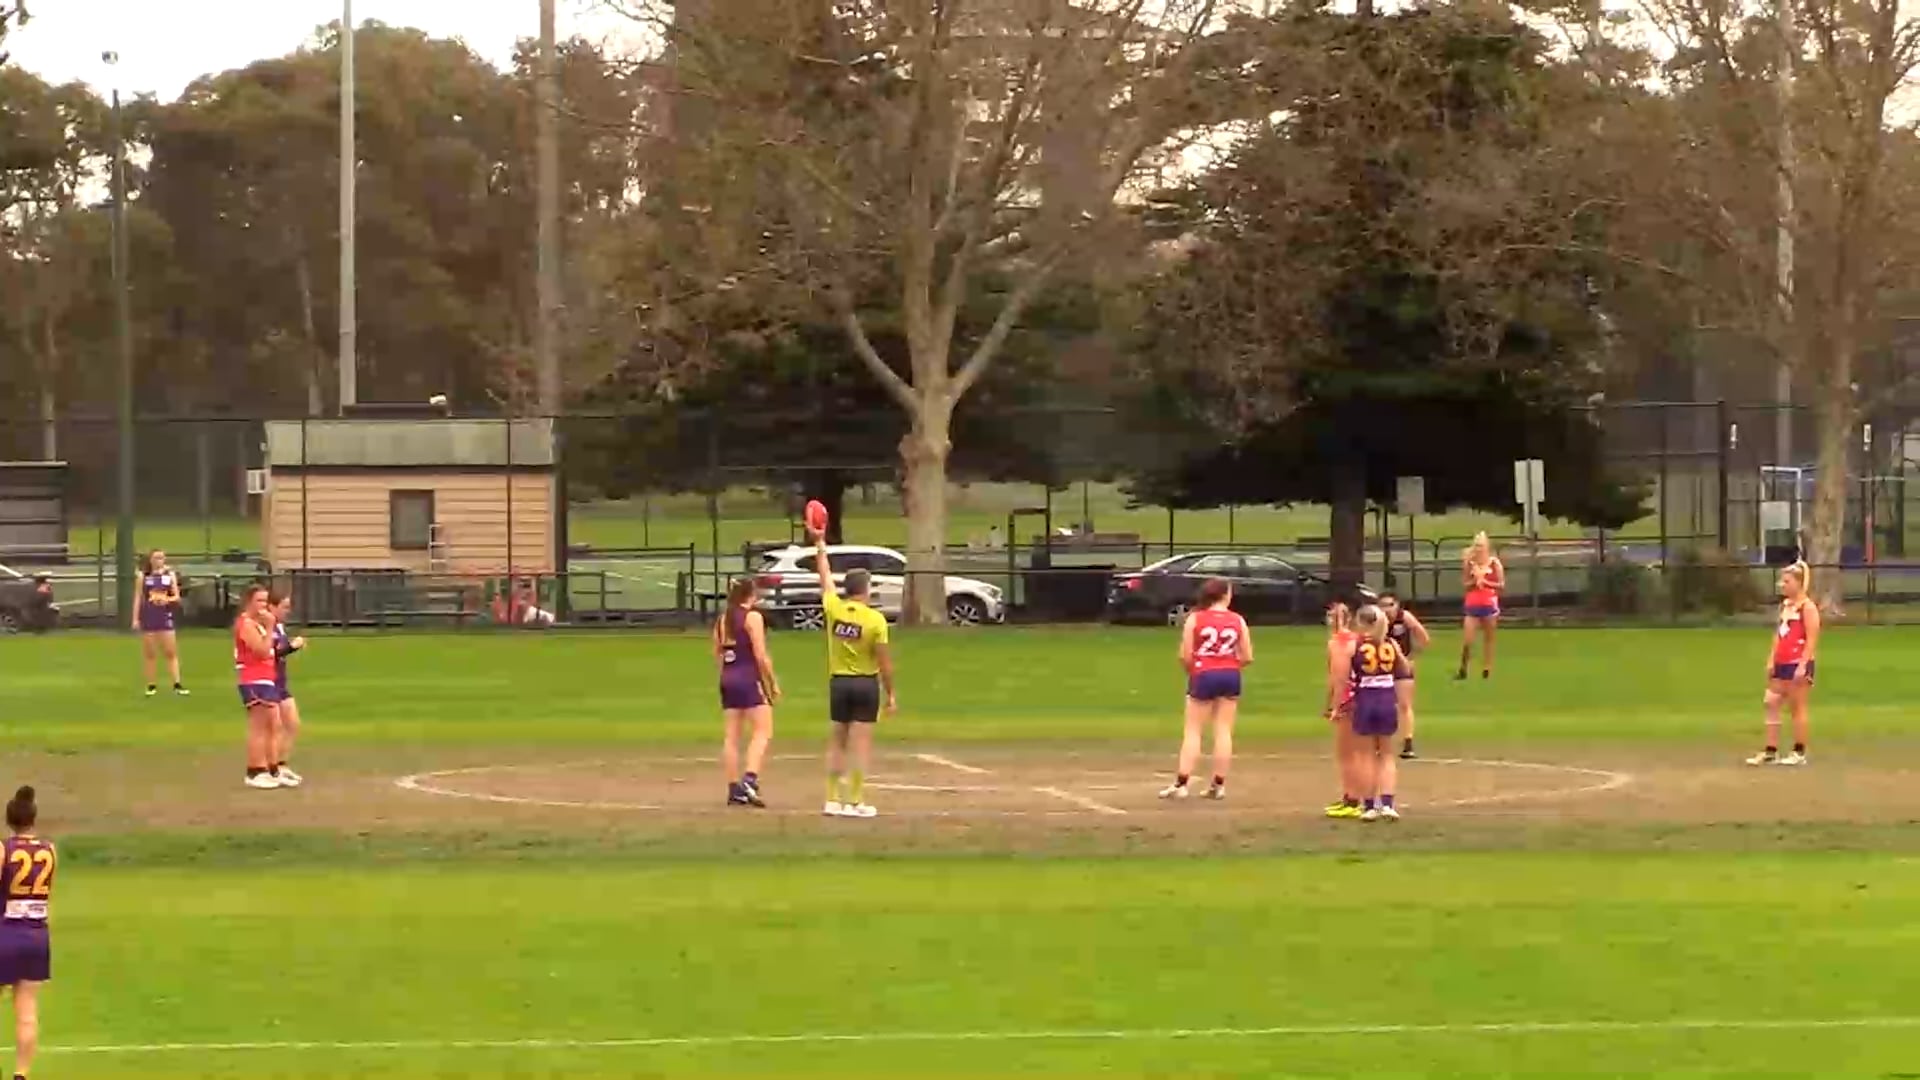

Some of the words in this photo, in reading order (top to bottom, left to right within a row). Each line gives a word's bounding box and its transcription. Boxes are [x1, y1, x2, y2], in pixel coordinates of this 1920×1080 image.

[1197, 626, 1238, 656] 22
[1360, 643, 1396, 674] 39
[9, 849, 53, 895] 22
